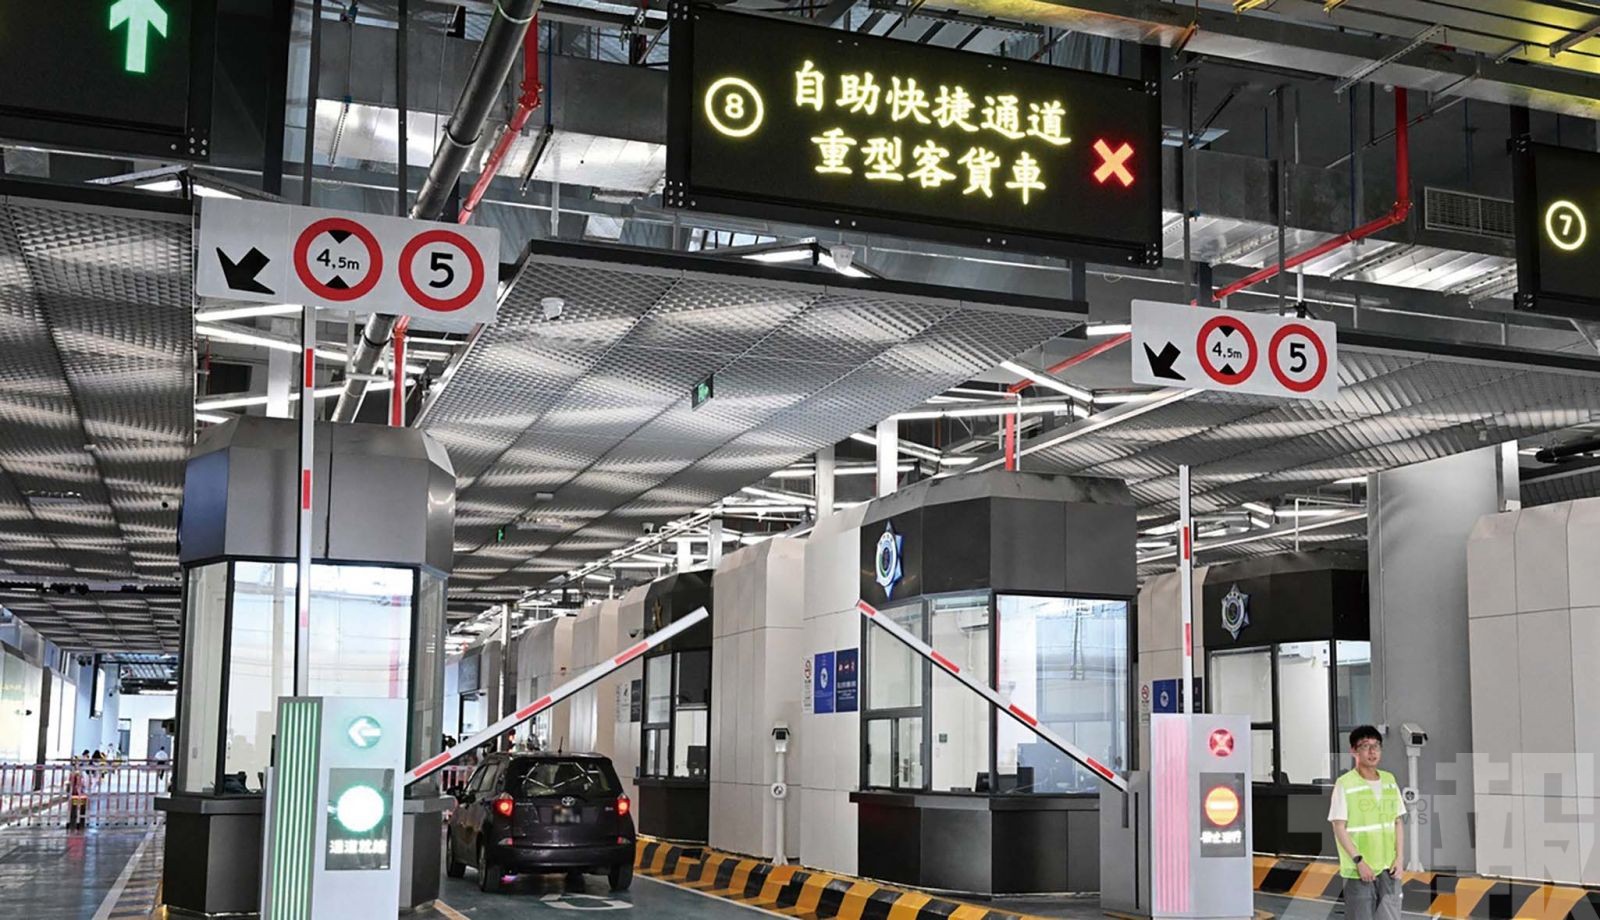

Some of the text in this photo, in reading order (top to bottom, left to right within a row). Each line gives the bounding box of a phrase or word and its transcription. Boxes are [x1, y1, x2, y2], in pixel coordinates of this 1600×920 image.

[725, 92, 744, 119] 8
[794, 60, 1072, 145] 自助快捷通道
[810, 127, 1048, 205] 重型客貨車
[1558, 213, 1573, 237] 7
[429, 252, 455, 289] 5
[1289, 342, 1308, 373] 5
